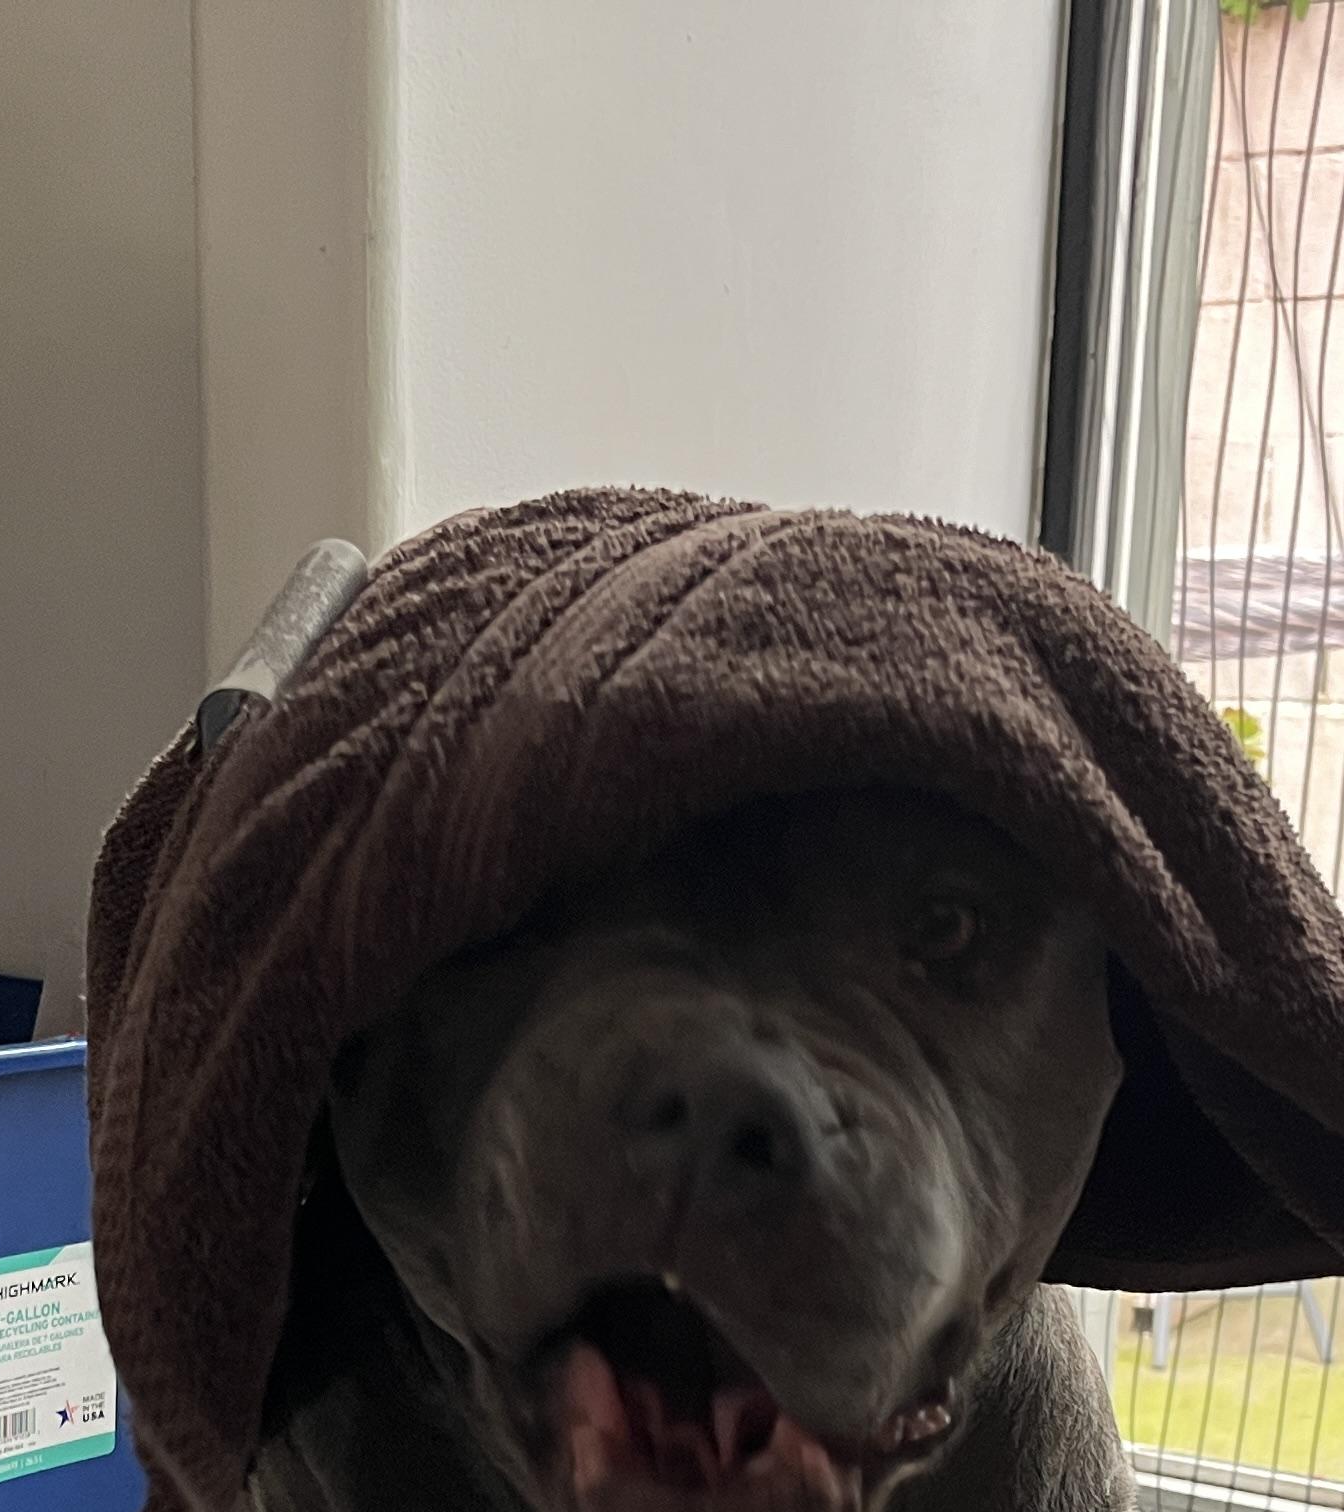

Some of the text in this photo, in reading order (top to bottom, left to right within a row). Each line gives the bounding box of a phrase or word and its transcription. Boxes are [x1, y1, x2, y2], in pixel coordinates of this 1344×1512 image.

[82, 1392, 105, 1403] MADE
[90, 1401, 105, 1411] THE
[82, 1410, 105, 1423] USA
